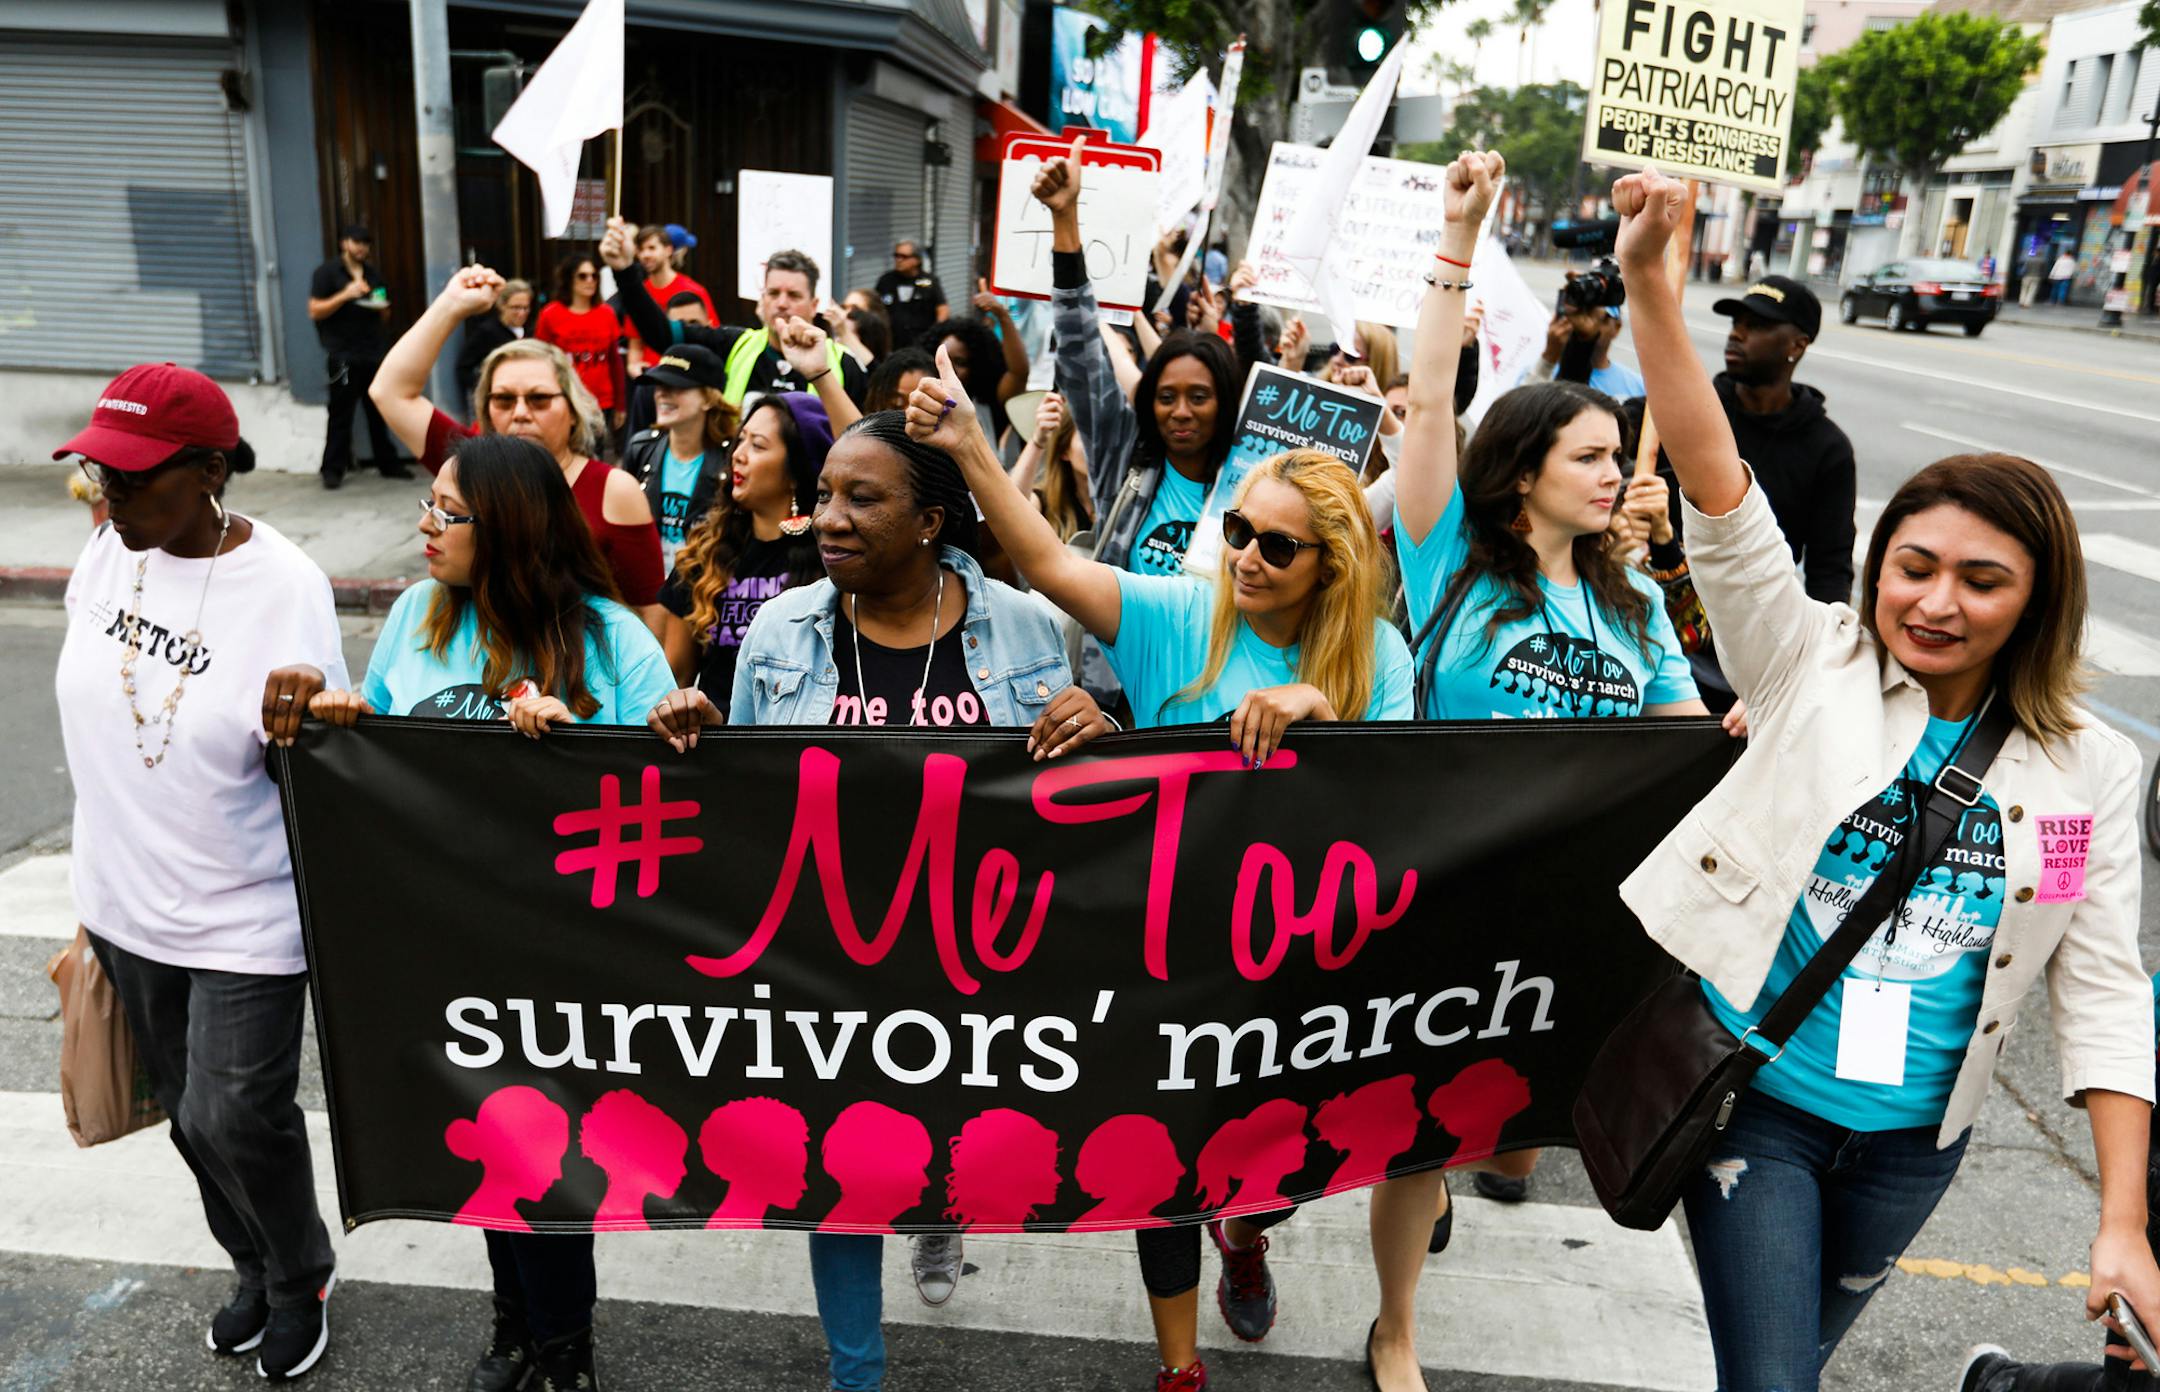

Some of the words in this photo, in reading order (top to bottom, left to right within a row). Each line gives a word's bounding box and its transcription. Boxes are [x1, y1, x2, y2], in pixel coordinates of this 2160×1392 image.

[1622, 0, 1787, 80] FIGHT
[1601, 57, 1788, 128] PATRIARCHY
[1600, 106, 1690, 141] PEOPLE'S
[1693, 124, 1780, 159] CONGRESS
[1623, 133, 1650, 155] OF
[1651, 138, 1756, 175] RESISTANCE
[1012, 230, 1131, 281] TO!
[1245, 419, 1314, 448] survivors'
[1313, 439, 1360, 464] march
[833, 694, 888, 726] me
[1842, 813, 1905, 847] surviv
[1944, 847, 2006, 870] marc
[2039, 819, 2092, 836] RISE
[2041, 839, 2089, 854] LOVE
[2043, 857, 2086, 869] RESIST
[1808, 877, 1856, 922] Holly
[444, 983, 1116, 1093] survivors'
[1156, 959, 1556, 1091] march
